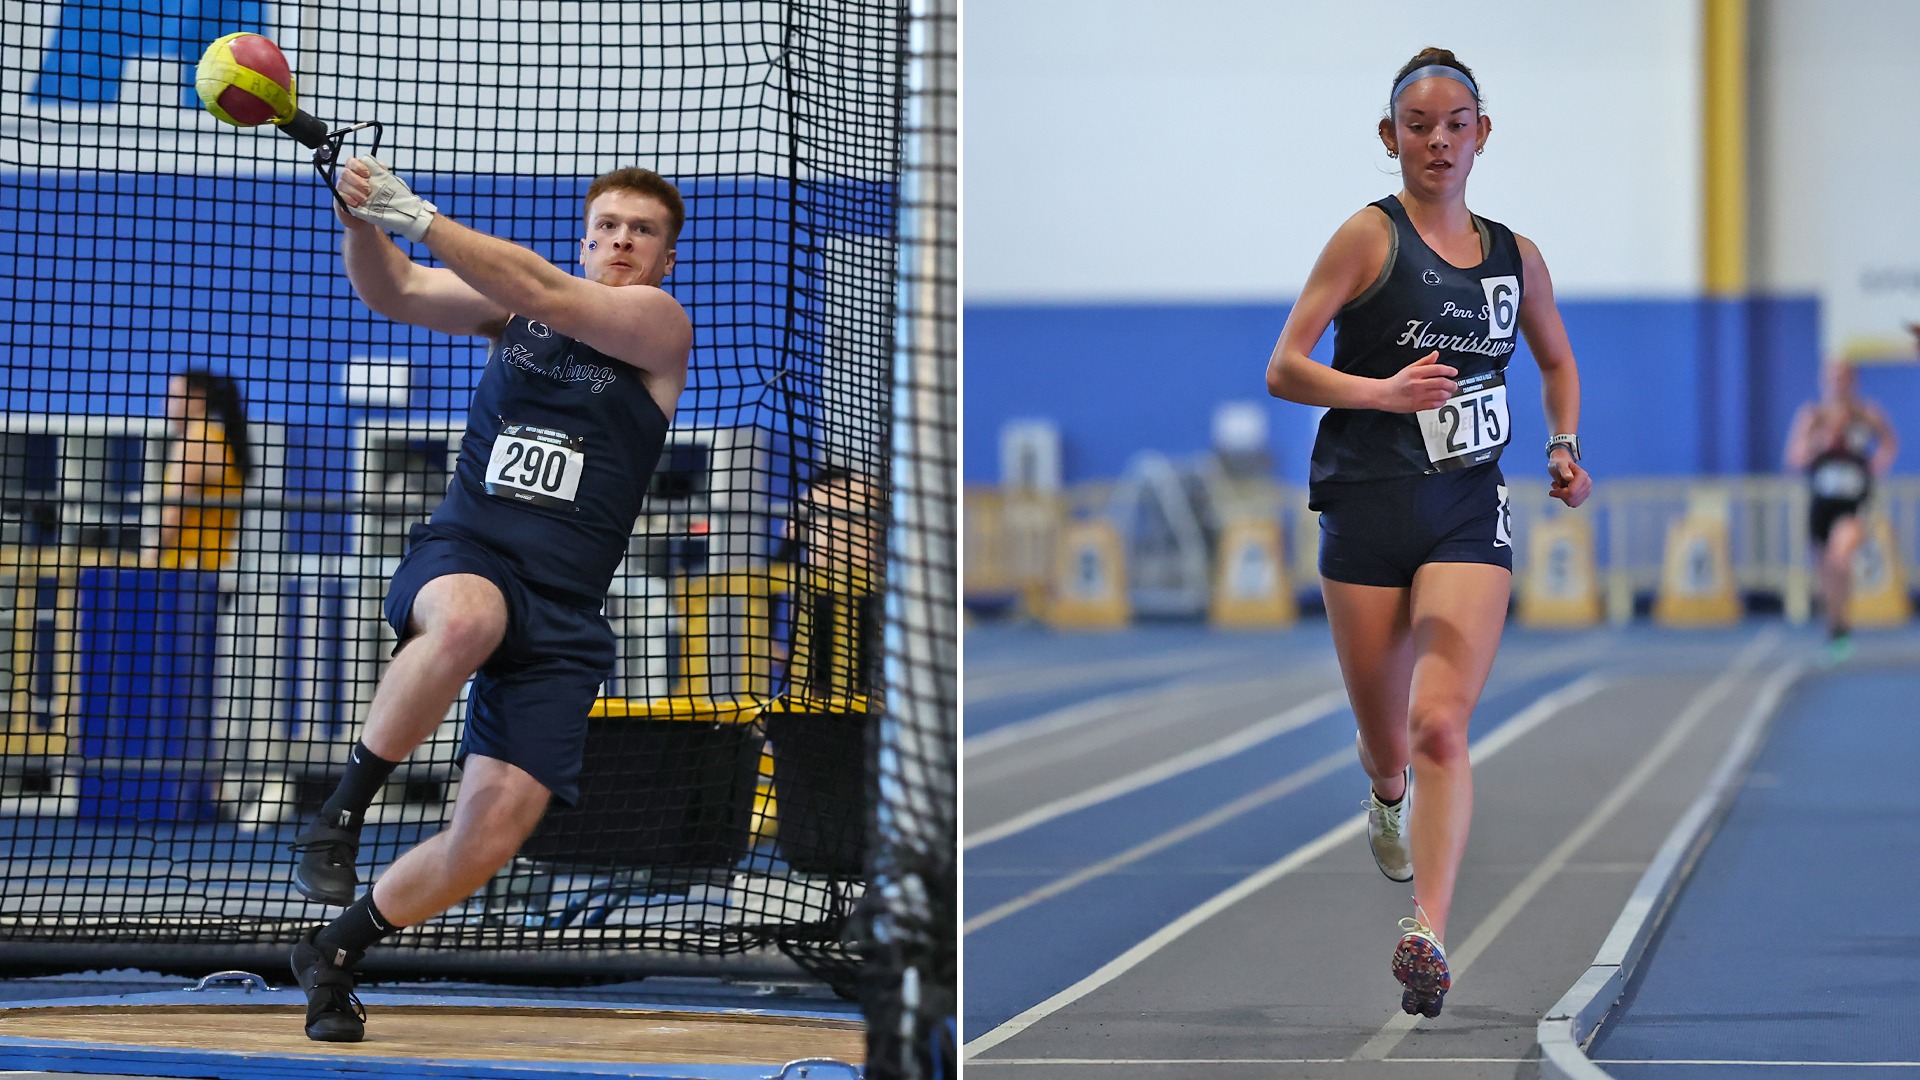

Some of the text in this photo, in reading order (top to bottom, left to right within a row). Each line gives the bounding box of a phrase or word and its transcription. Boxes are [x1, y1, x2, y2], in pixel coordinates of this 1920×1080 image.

[1440, 301, 1474, 319] Penn
[1492, 284, 1513, 330] 6
[502, 343, 616, 393] Hasburg
[1438, 394, 1500, 453] 275
[498, 441, 567, 492] 290
